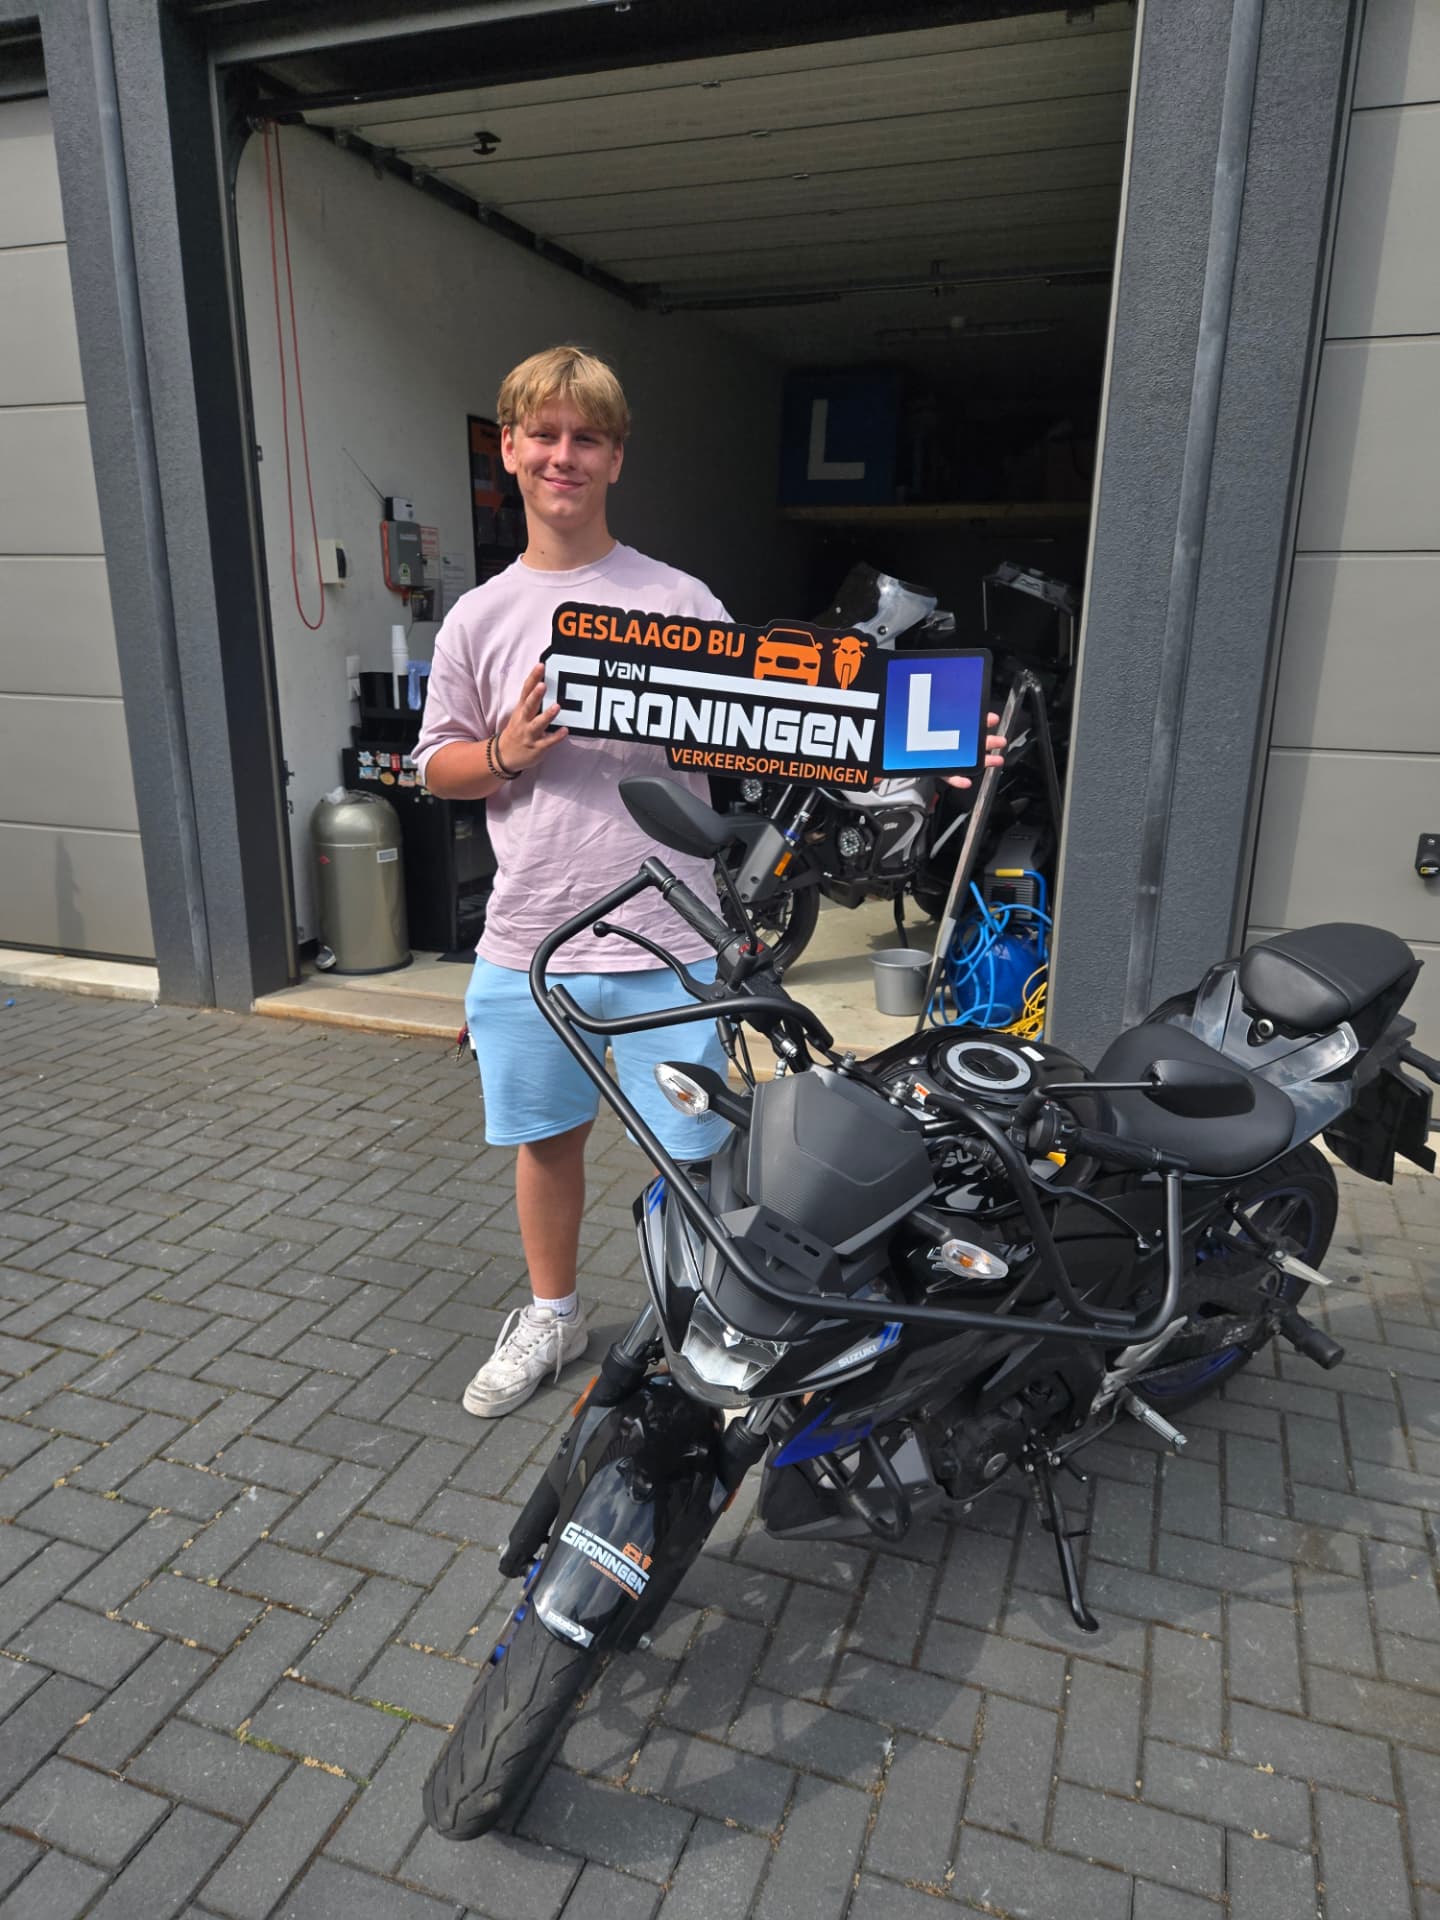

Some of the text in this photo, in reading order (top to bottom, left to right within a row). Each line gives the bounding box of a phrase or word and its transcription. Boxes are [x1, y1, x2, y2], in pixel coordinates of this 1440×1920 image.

[807, 399, 866, 480] L
[558, 611, 745, 659] GESLAAGD BIJ
[907, 673, 960, 751] L
[672, 747, 868, 785] VERKEERSOPLEIDINGEN
[838, 1344, 878, 1368] SUZUKI
